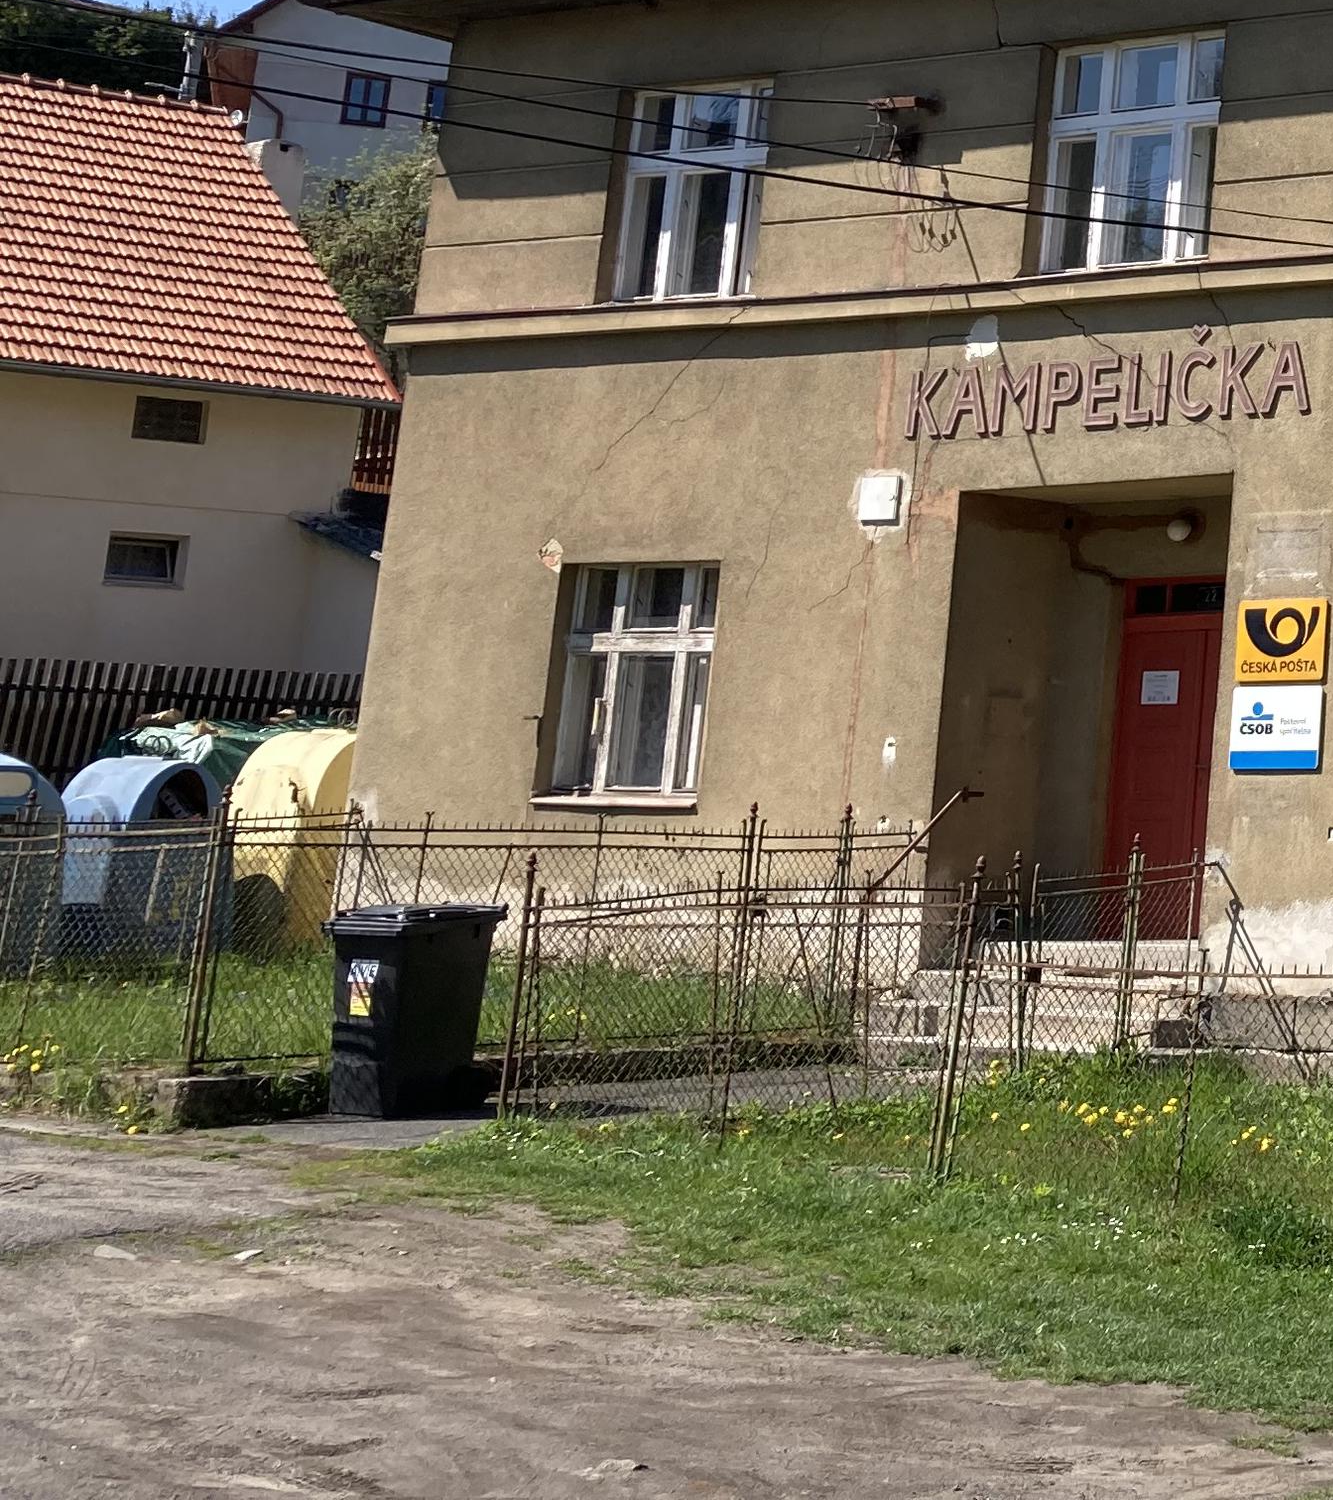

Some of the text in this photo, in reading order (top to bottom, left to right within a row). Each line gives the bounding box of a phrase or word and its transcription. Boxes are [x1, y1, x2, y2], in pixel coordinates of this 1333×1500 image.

[904, 324, 1312, 440] KAMPELIČKA
[1240, 658, 1318, 674] ČESKÁ POŠTA
[1239, 722, 1274, 735] ČSOB
